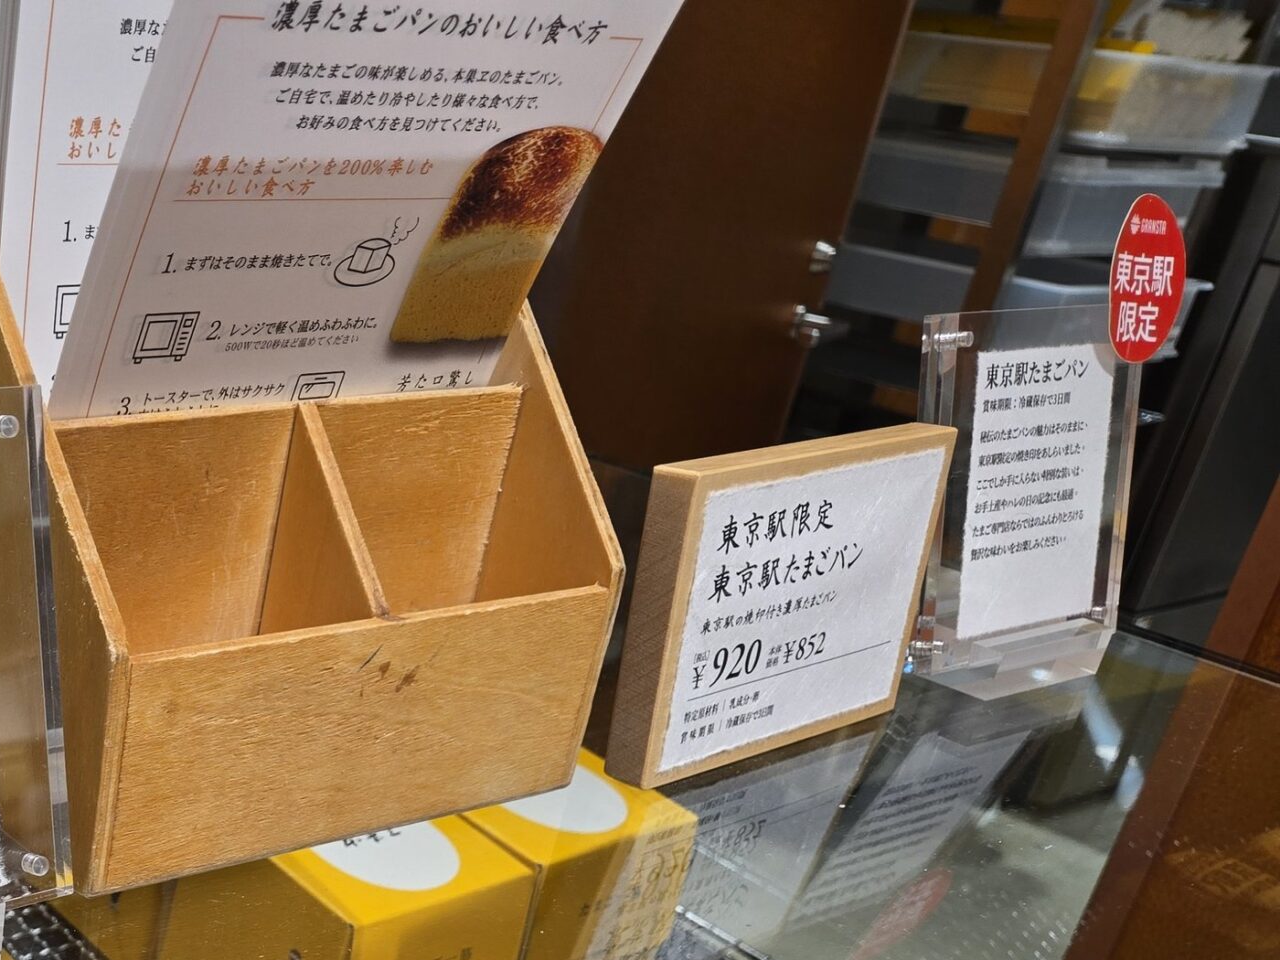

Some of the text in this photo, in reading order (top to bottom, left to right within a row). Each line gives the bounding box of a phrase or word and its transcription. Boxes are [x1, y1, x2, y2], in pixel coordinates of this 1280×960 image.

[120, 19, 167, 35] 濃厚な
[271, 0, 608, 45] 濃厚たまごパンのおいしい食べ方
[131, 46, 156, 63] ご自
[69, 117, 134, 138] 濃厚た
[295, 115, 501, 133] お好みの食べ方を見つけてください。
[68, 141, 116, 160] おいし
[185, 177, 316, 198] おいしい食べ方
[184, 253, 332, 272] まずはそのまま焼きたてで。
[1114, 250, 1175, 297] 東京駅
[229, 315, 378, 338] レンジで軽く温めふわふわに。
[1115, 301, 1159, 343] 限定
[984, 359, 1089, 390] 東京駅たまごパン
[717, 499, 834, 555] 東京駅限定
[708, 542, 864, 603] 東京駅たまごパン
[709, 638, 763, 688] 920
